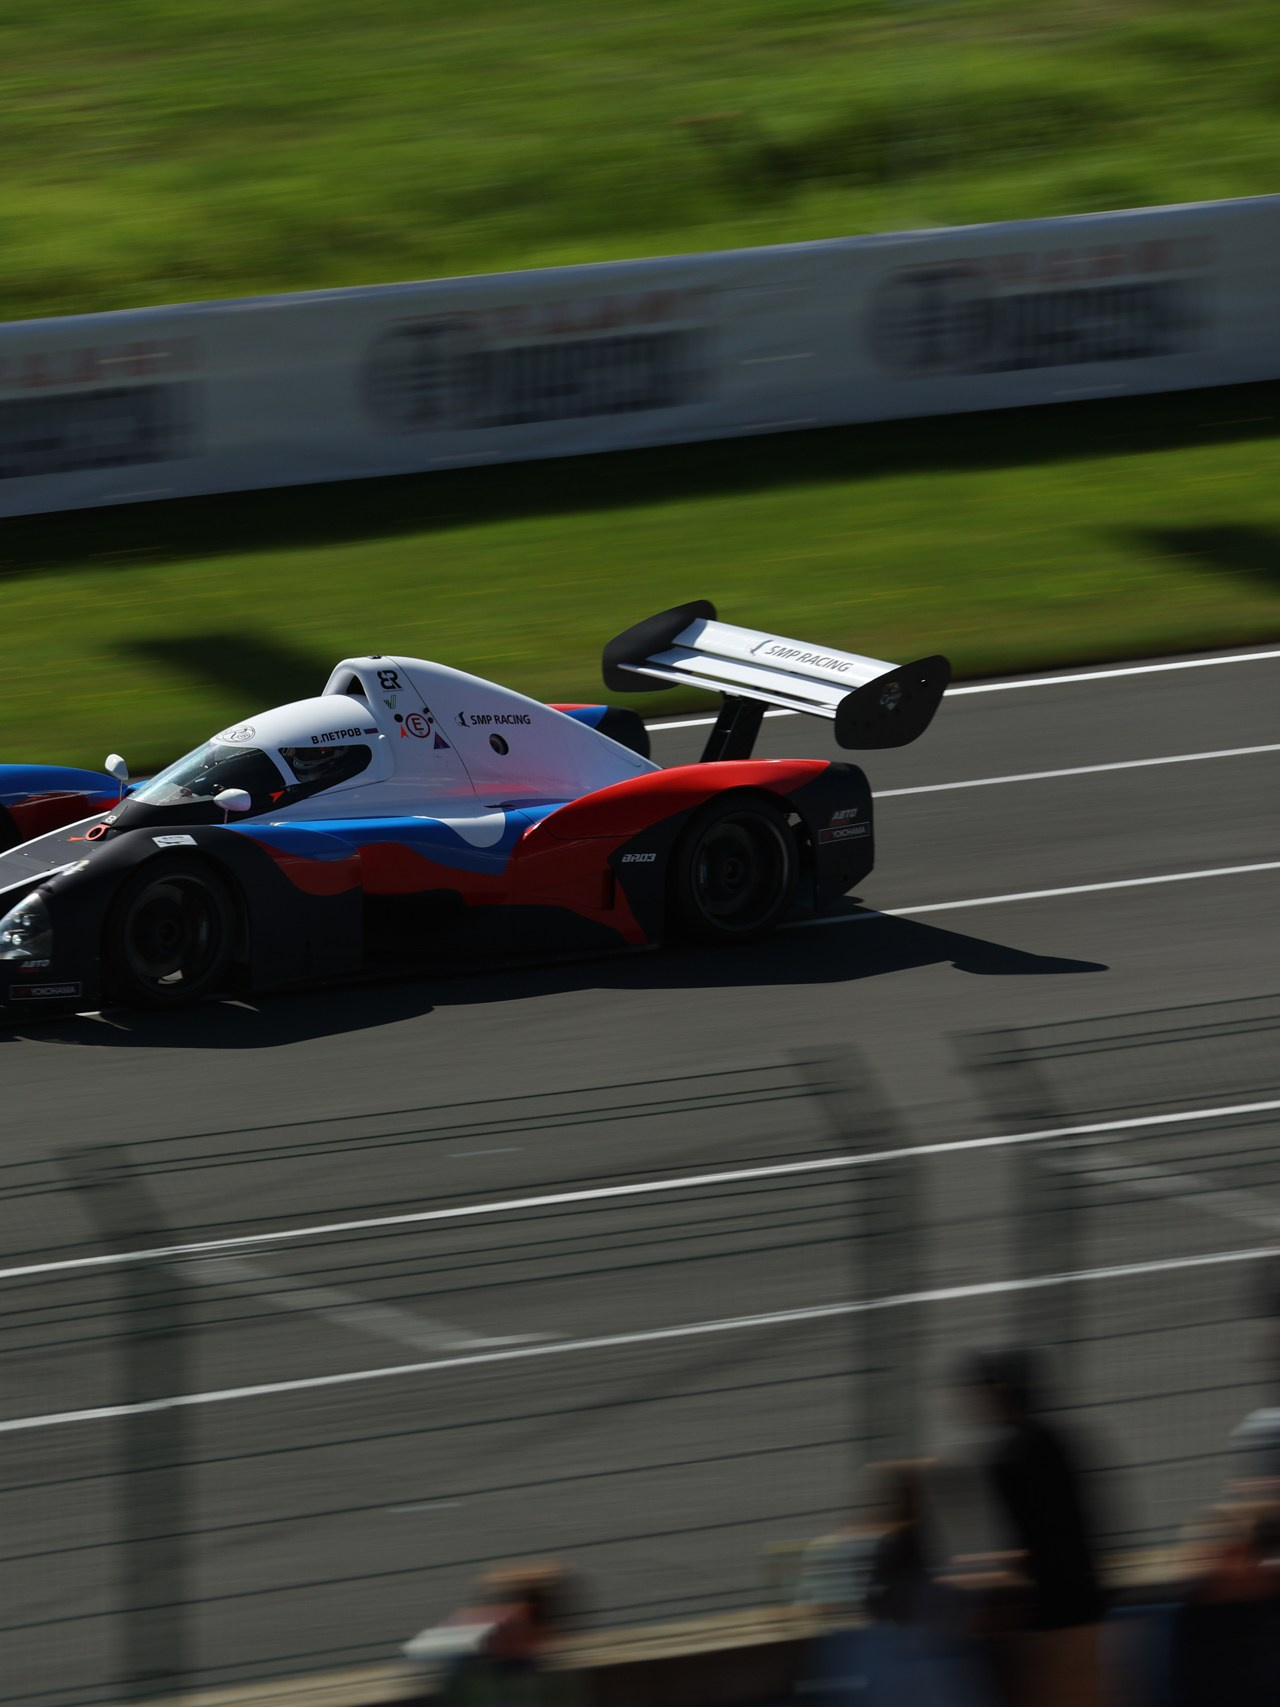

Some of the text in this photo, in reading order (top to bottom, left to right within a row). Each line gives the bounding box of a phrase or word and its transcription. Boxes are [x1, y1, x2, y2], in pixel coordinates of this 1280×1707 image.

[765, 645, 854, 673] SMP RACING
[411, 717, 424, 731] E
[470, 714, 531, 725] SMP RACING
[311, 727, 362, 745] В.ПЕТРОВ
